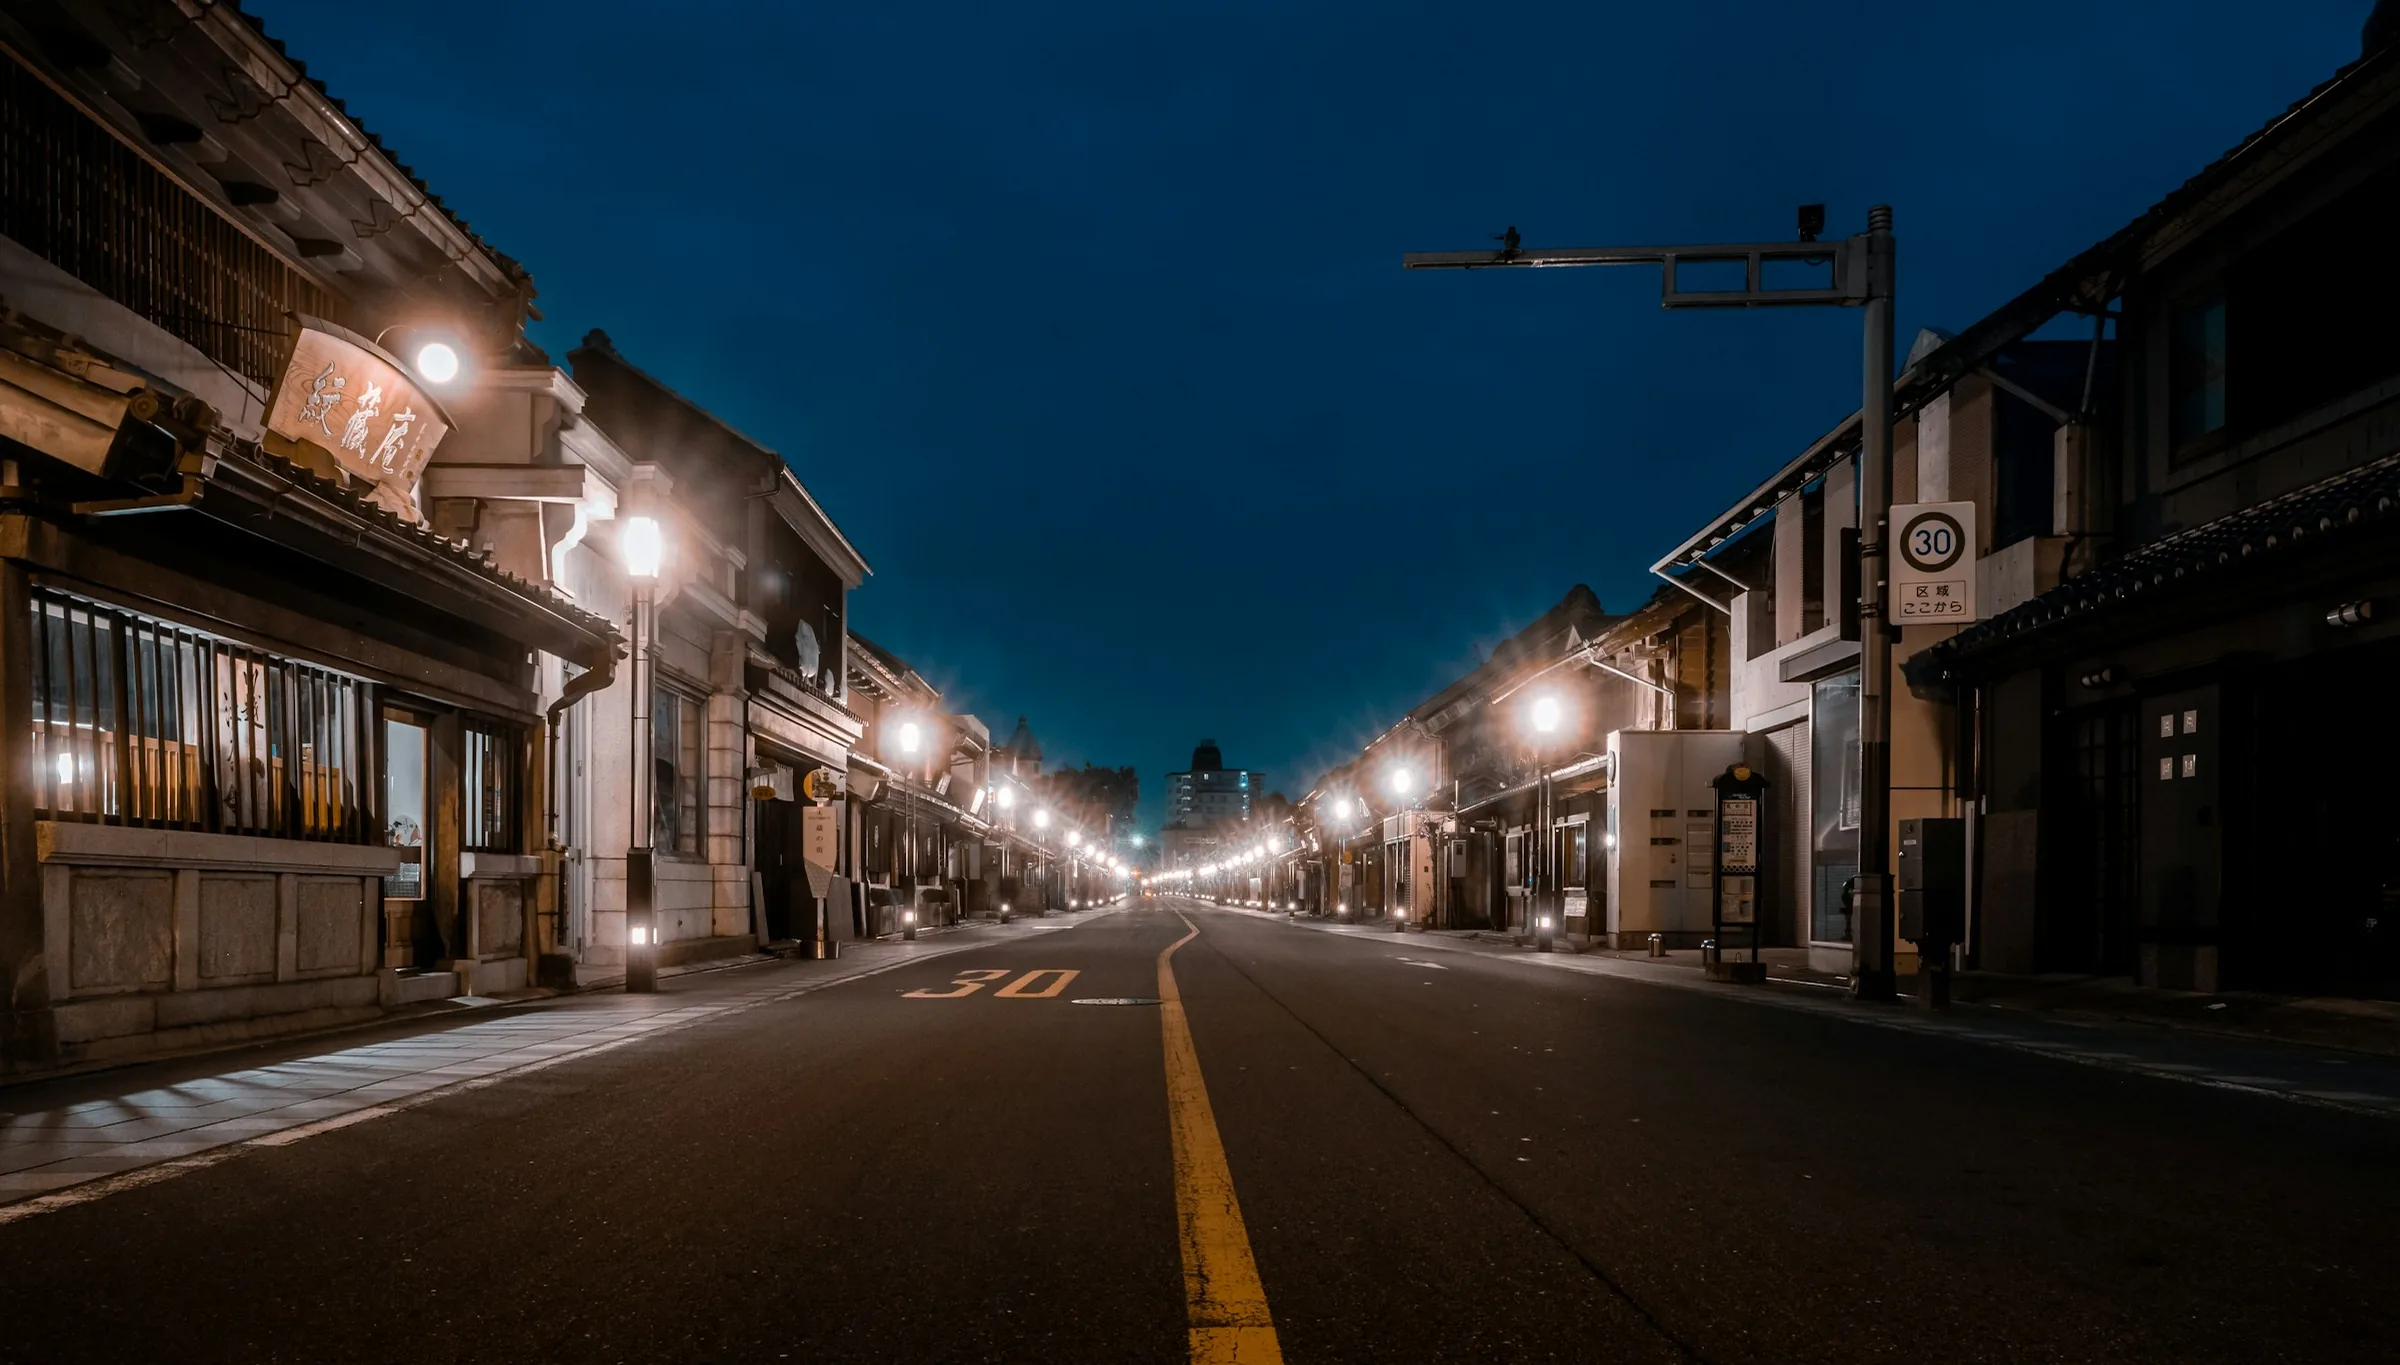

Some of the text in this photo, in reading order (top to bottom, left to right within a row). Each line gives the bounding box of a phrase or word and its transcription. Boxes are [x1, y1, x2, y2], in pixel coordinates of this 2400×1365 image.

[1915, 528, 1951, 555] 30
[1916, 584, 1950, 598] 区域
[1903, 601, 1962, 614] ここから
[900, 969, 1081, 998] 30
